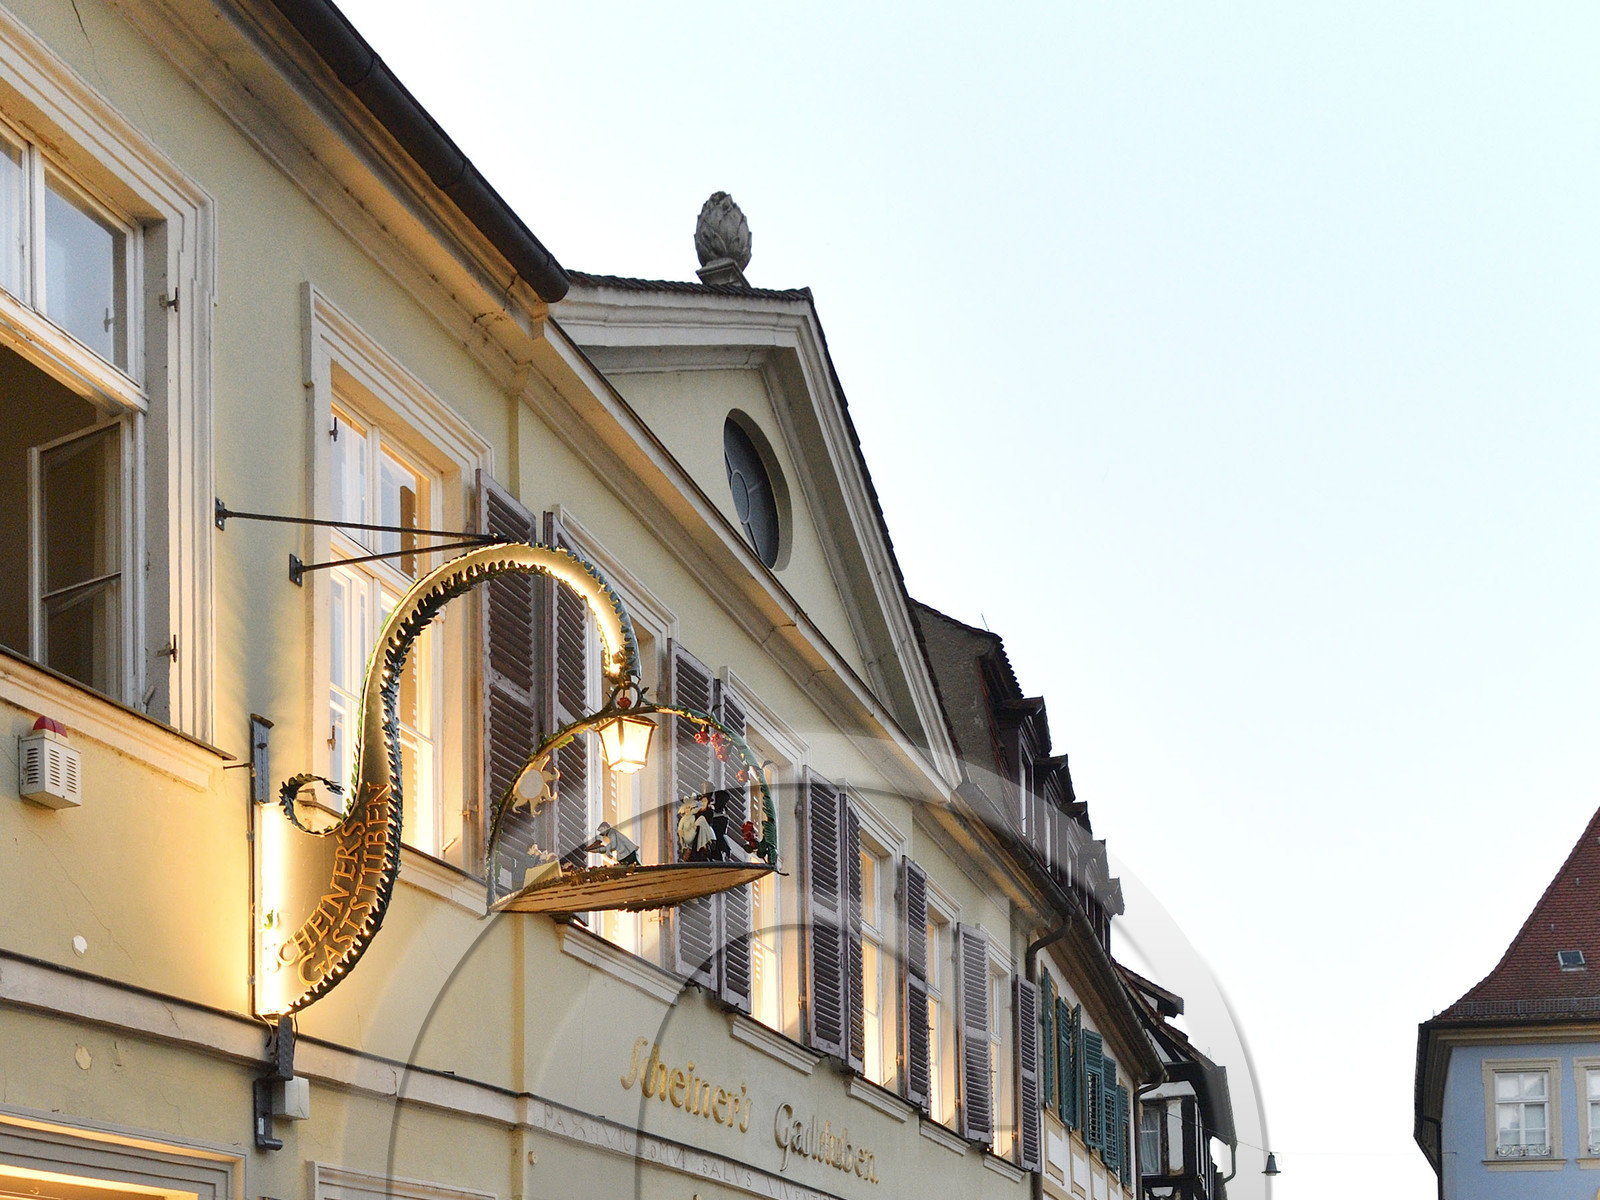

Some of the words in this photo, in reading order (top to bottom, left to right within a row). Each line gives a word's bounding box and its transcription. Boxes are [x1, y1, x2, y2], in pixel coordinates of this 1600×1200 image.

[268, 820, 366, 970] CHEINER'S
[297, 781, 392, 988] GASTSTUBEN
[620, 1036, 753, 1134] Scheiner's
